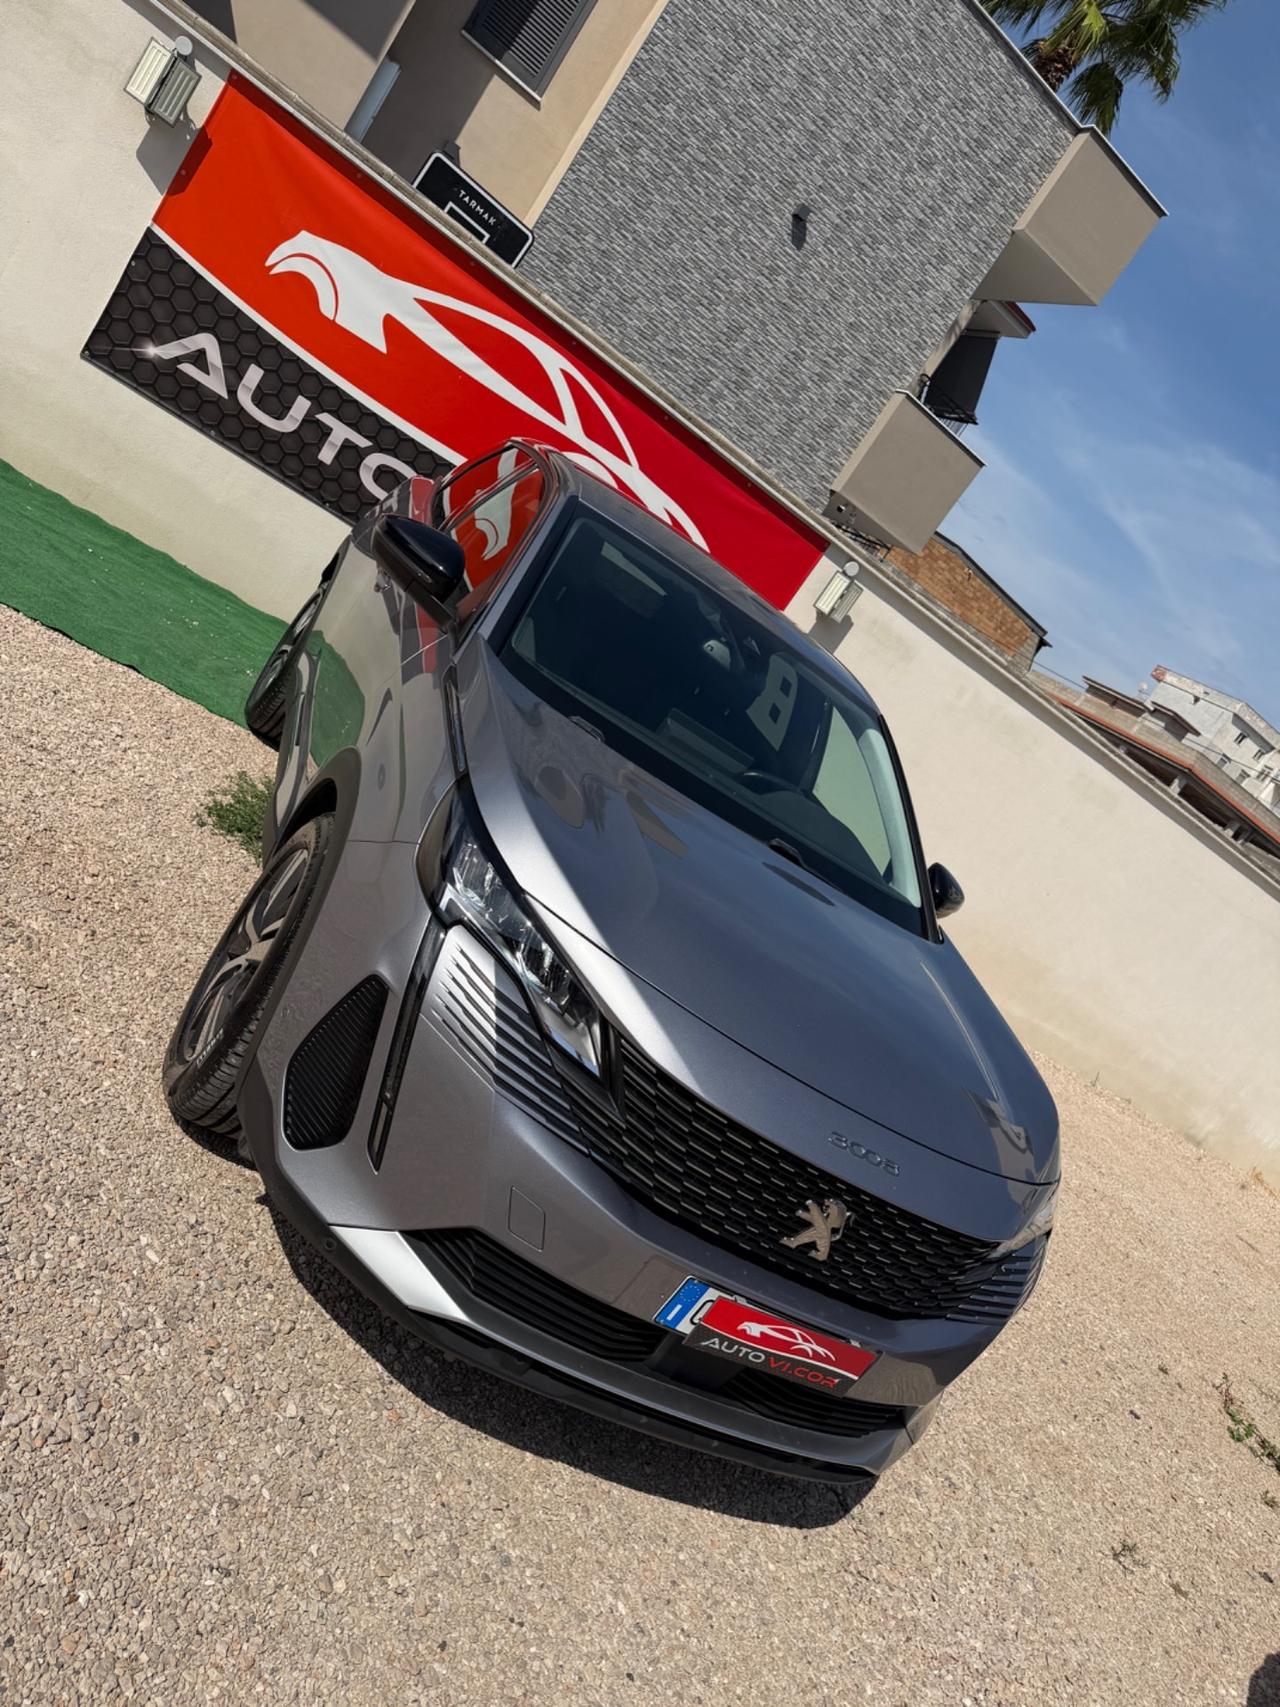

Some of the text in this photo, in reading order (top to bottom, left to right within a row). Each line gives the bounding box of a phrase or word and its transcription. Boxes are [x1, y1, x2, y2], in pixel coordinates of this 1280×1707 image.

[458, 189, 497, 226] TARMAK
[151, 332, 418, 501] AUTO
[827, 1130, 901, 1178] 3008
[700, 1337, 766, 1363] AUTO
